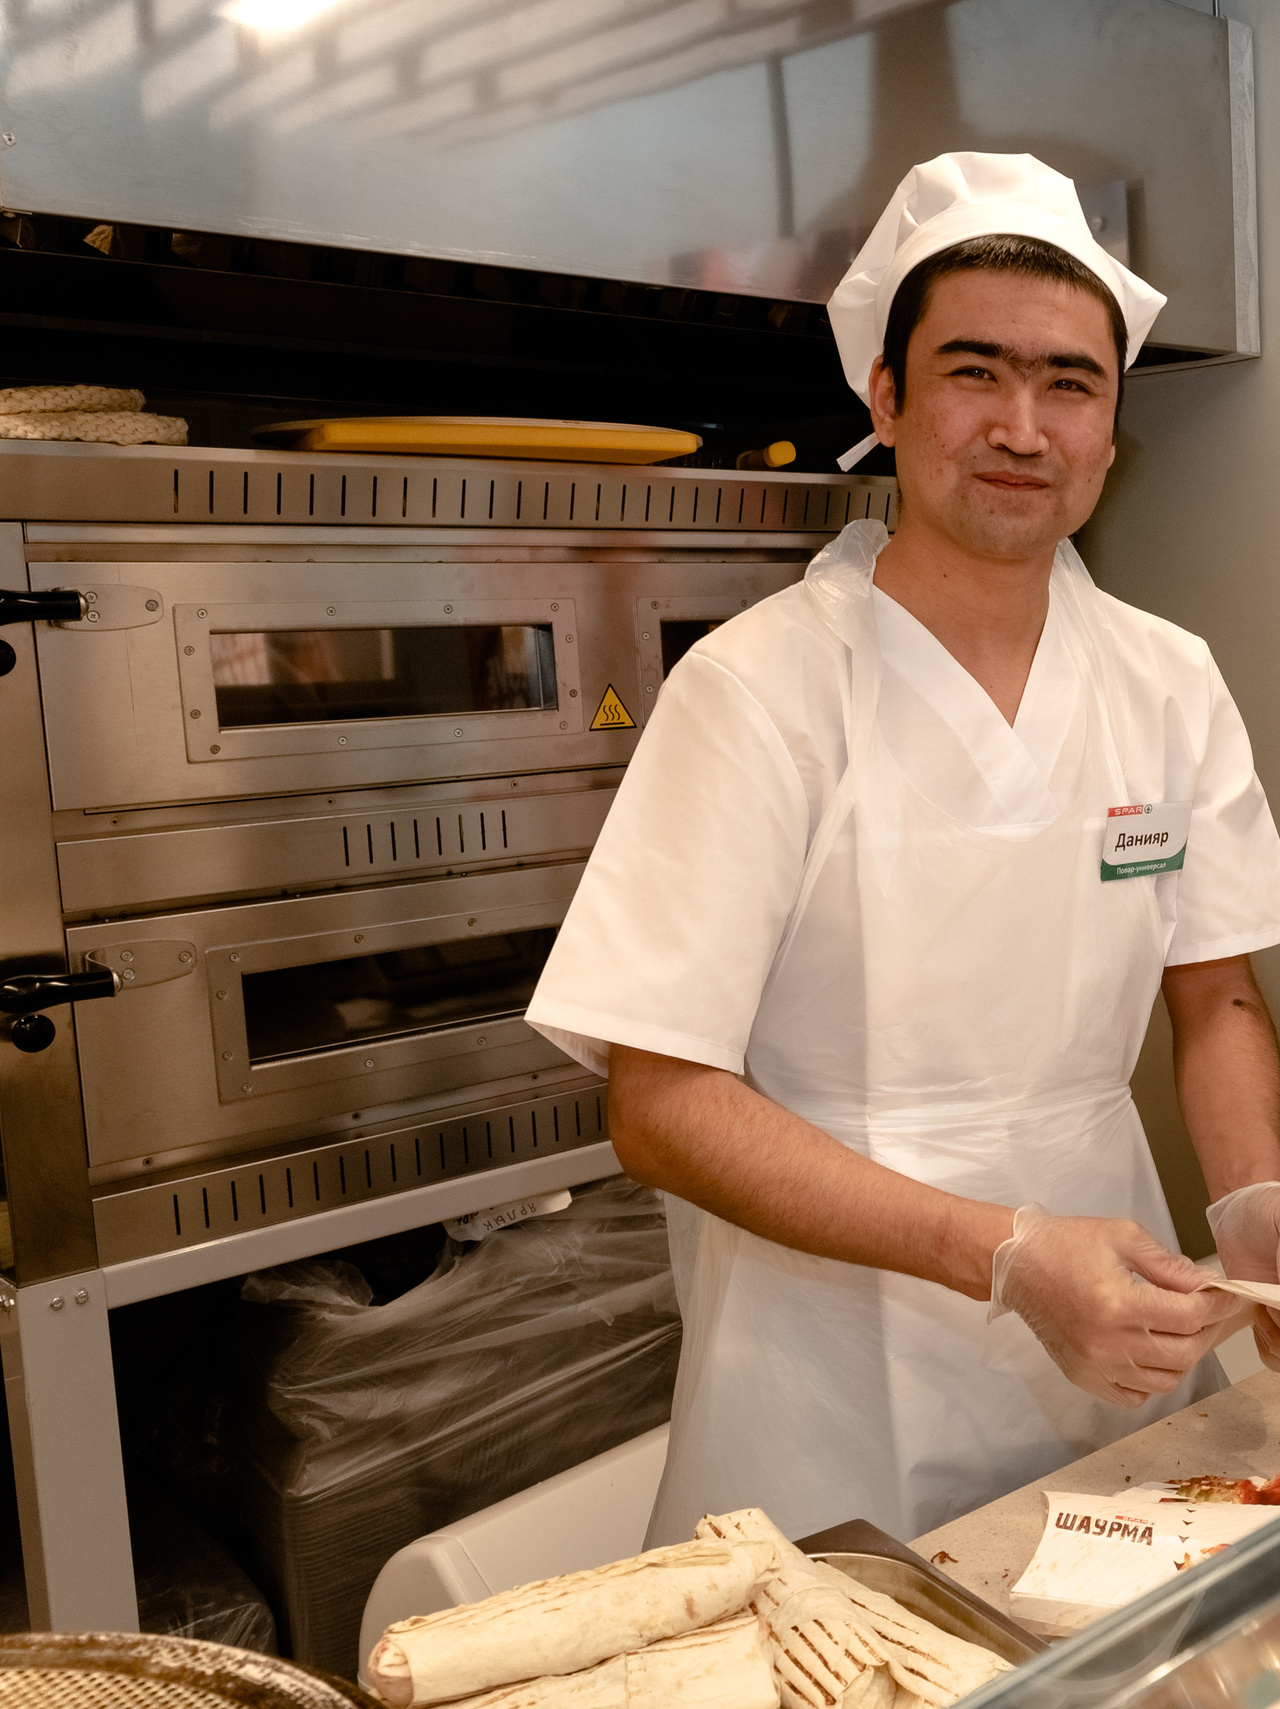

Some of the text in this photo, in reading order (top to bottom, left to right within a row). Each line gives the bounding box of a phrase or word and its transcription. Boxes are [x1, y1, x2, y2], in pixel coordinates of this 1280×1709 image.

[1114, 806, 1143, 816] SPAR
[1114, 831, 1169, 852] Данияр
[483, 1202, 537, 1231] ЯРЛЫК
[1055, 1512, 1153, 1546] ШАУРМА
